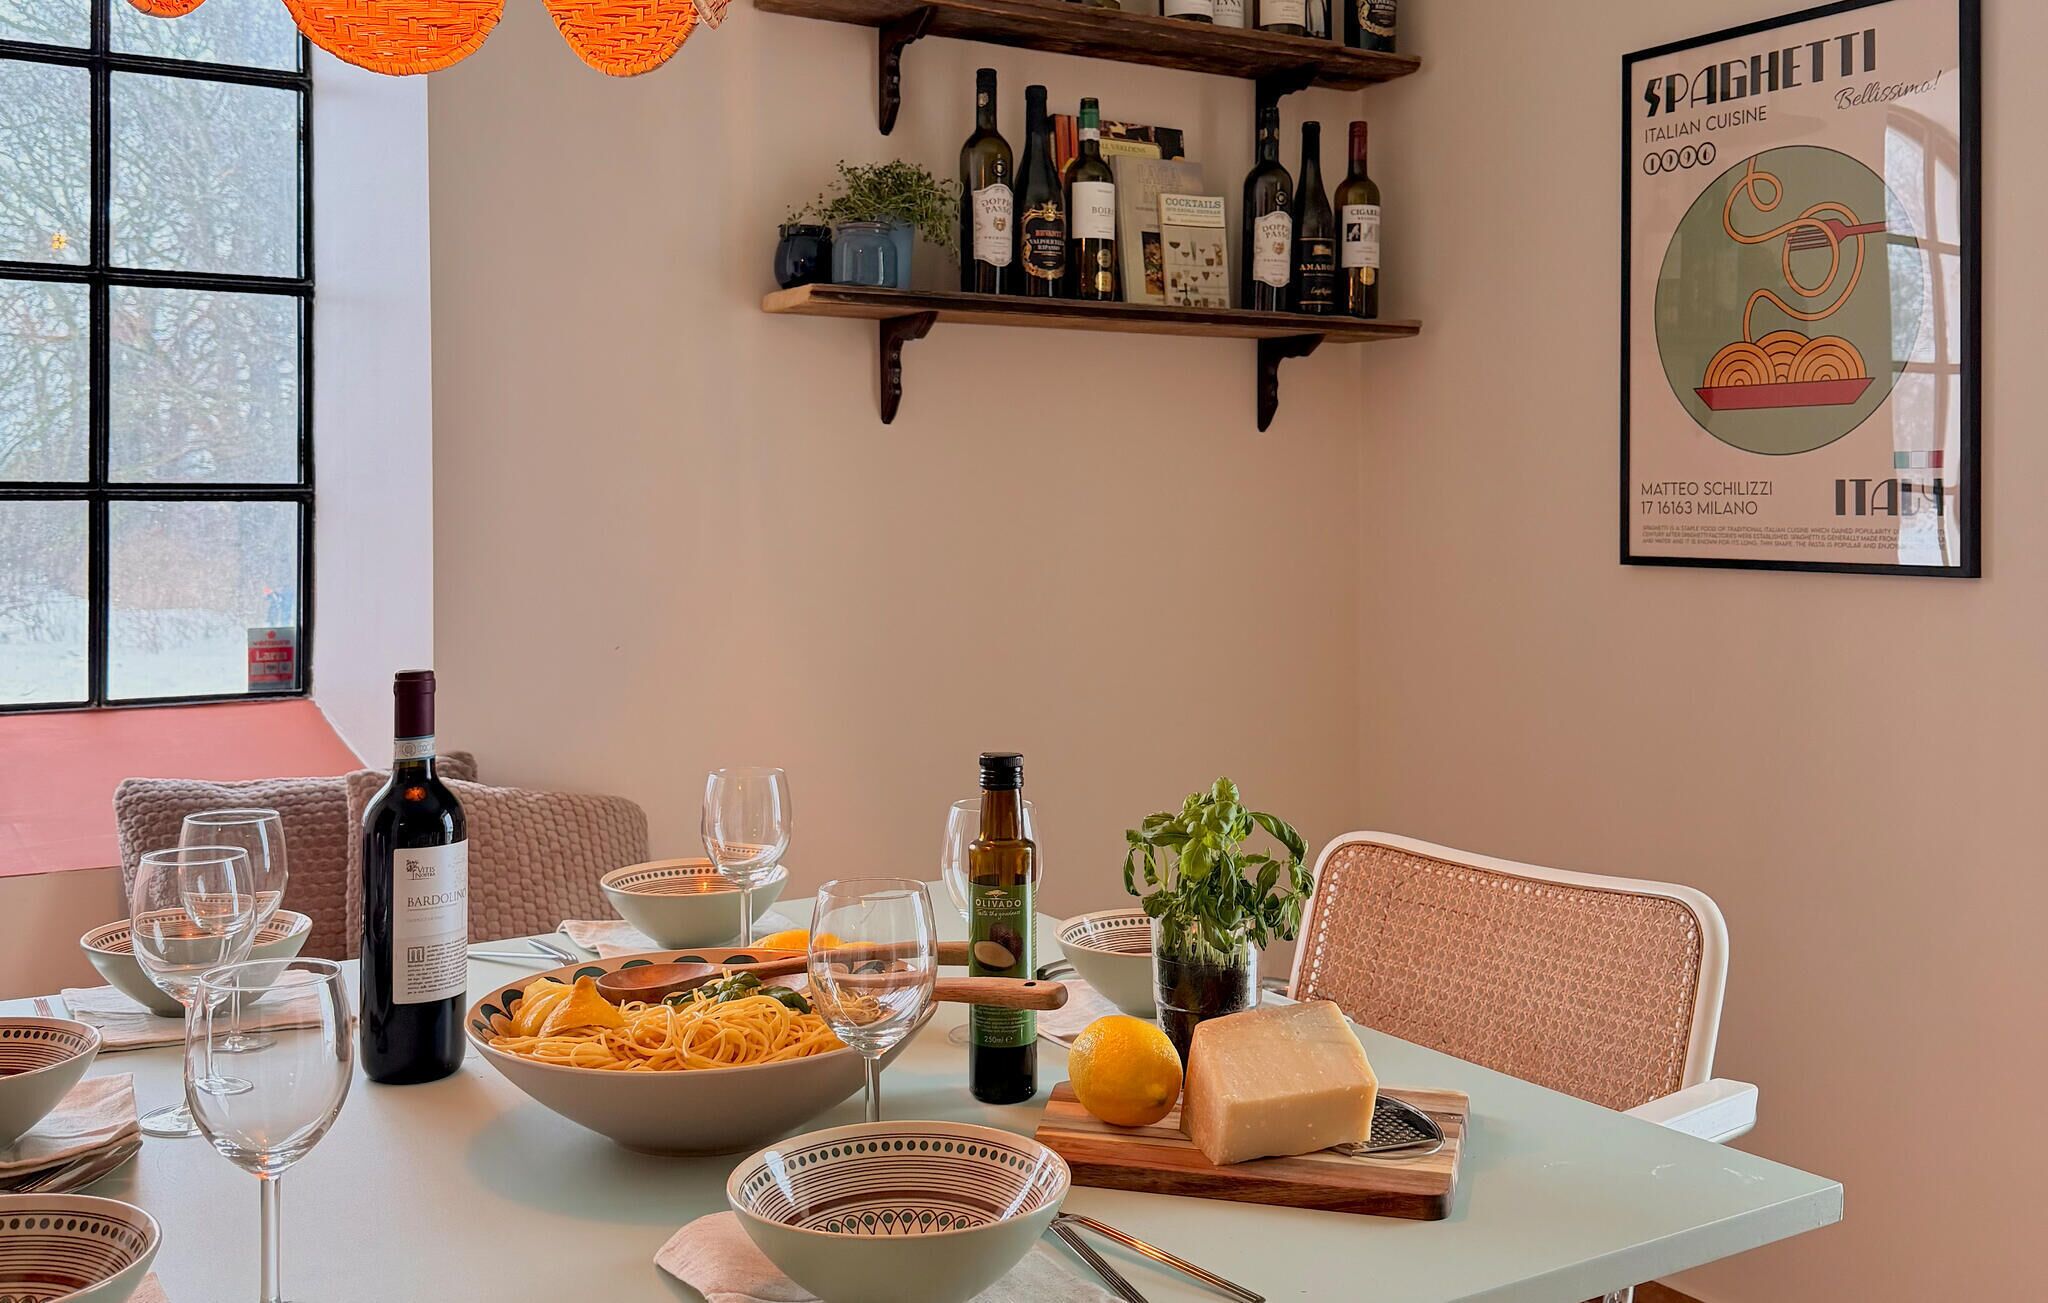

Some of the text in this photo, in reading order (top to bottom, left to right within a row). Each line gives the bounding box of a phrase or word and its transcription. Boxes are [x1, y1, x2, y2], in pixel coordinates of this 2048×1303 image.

[1644, 28, 1876, 118] SPAGHETTI
[1834, 70, 1942, 110] Bellissimo!
[1645, 105, 1767, 144] ITALIAN CUISINE
[1166, 198, 1221, 208] COCKTAILS
[1641, 481, 1773, 496] MATTEO SCHILIZZI
[1835, 478, 1944, 516] ITALY
[1641, 500, 1758, 515] 17 16163 MILANO
[408, 888, 466, 907] BARDOLINO
[975, 898, 1022, 908] OLIVADO
[984, 1035, 1003, 1043] 250ml
